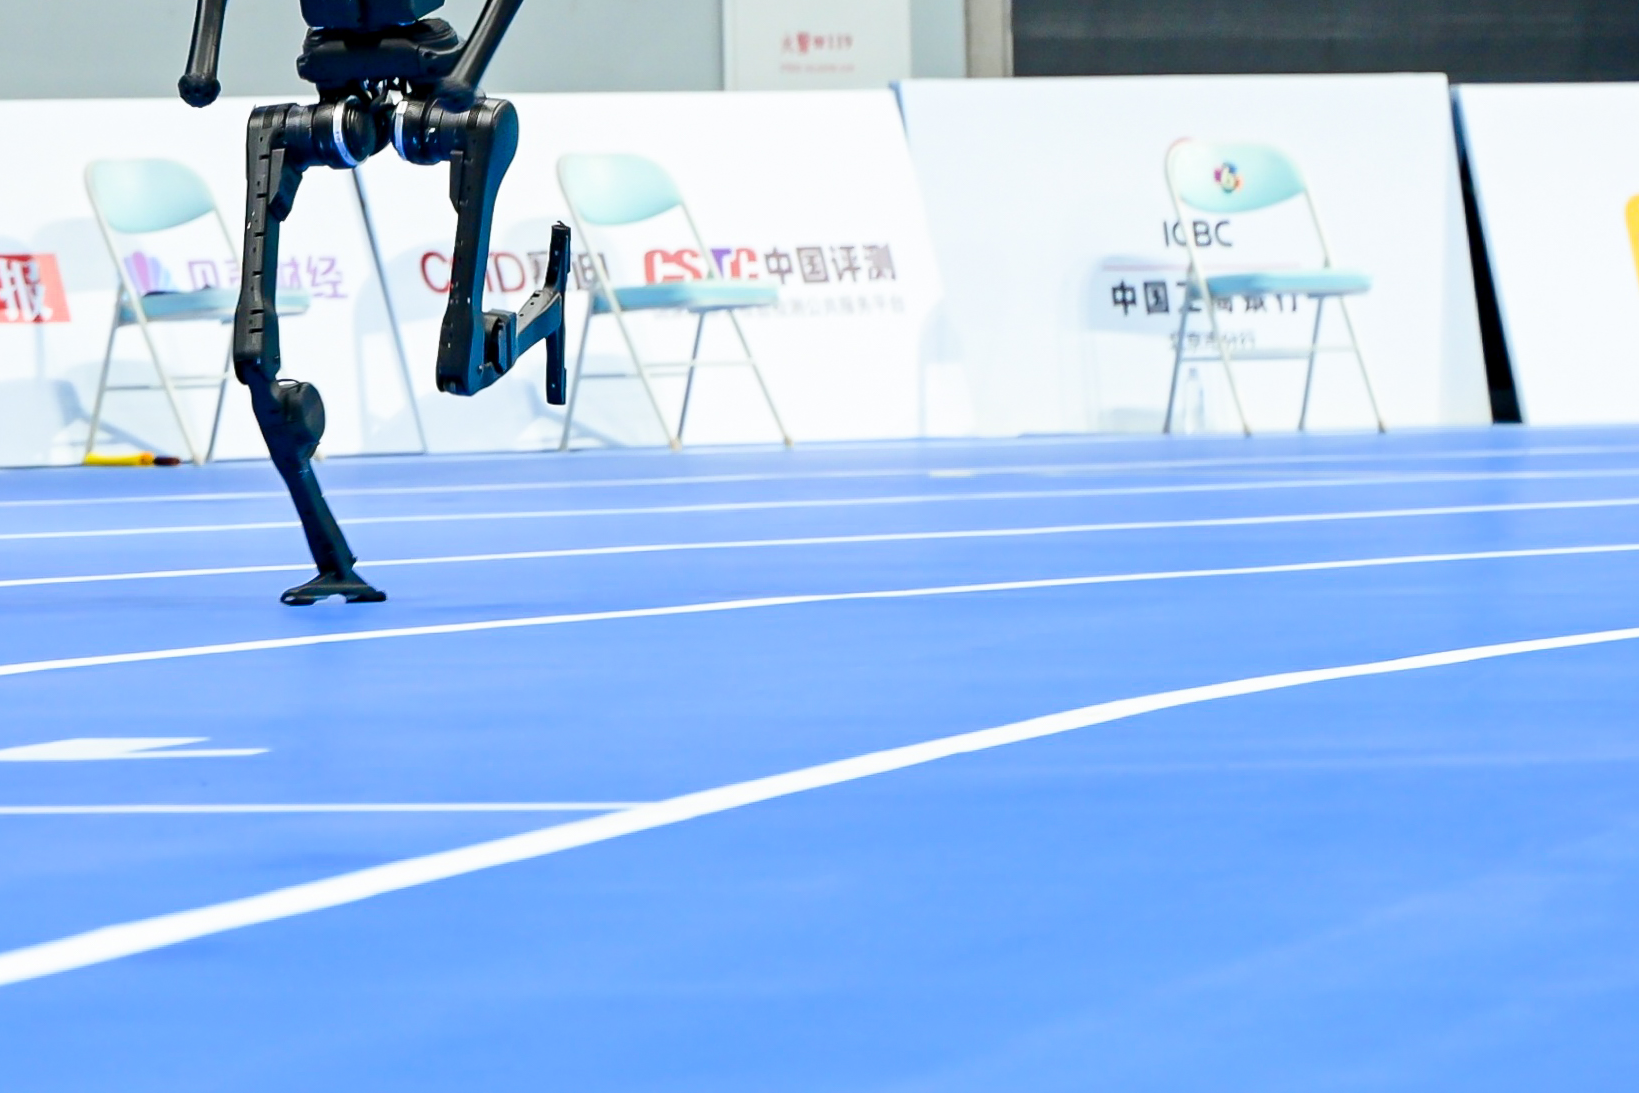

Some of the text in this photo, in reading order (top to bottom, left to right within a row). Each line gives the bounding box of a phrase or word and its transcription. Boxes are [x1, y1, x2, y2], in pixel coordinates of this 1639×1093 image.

[1163, 220, 1233, 247] ICBC
[420, 251, 526, 294] CID
[644, 243, 898, 286] CSTC 中国评测
